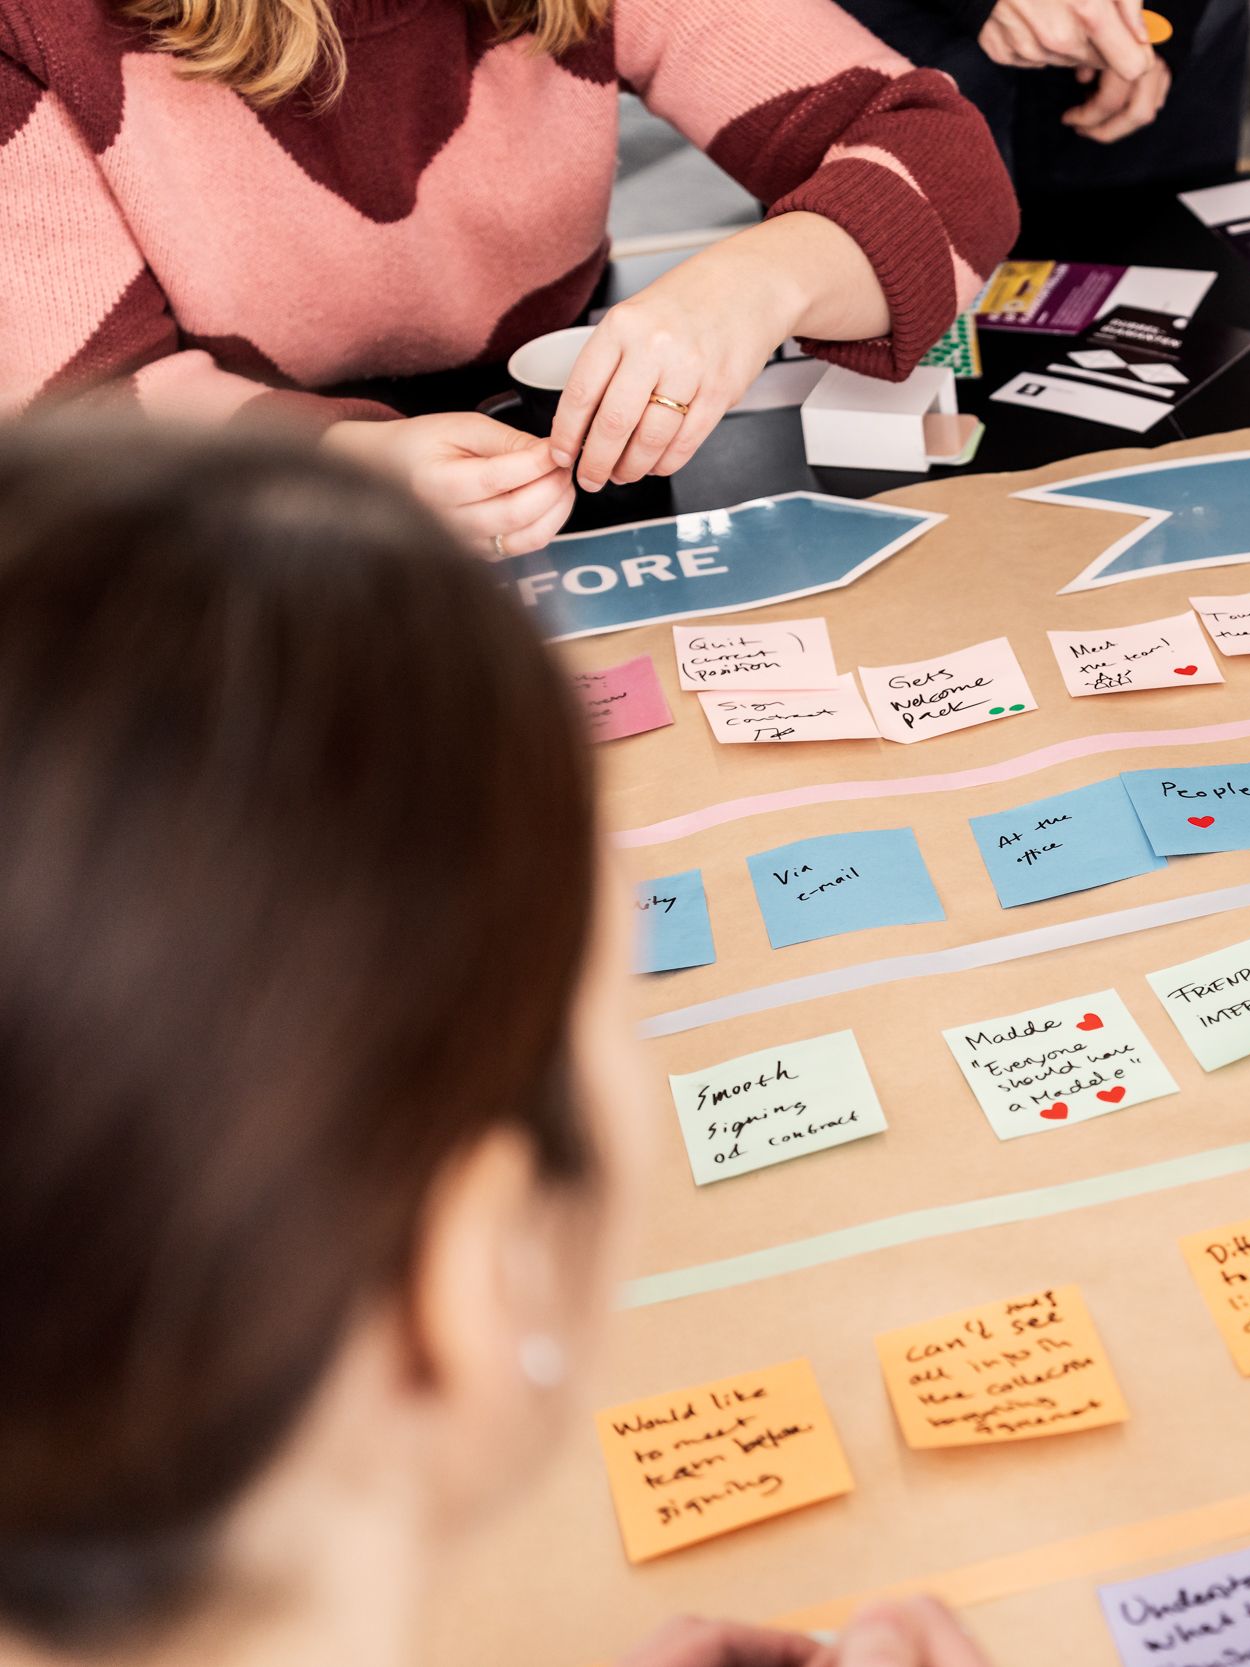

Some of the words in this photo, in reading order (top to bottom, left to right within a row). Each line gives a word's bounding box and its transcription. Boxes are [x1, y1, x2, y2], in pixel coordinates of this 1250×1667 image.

[512, 545, 729, 607] FORE
[688, 637, 762, 651] Quit
[1069, 640, 1119, 659] Meet
[888, 668, 954, 690] Gets
[1080, 662, 1118, 674] the
[717, 701, 785, 712] Sign
[998, 832, 1023, 849] At
[1034, 814, 1073, 831] the
[1016, 842, 1064, 866] office
[772, 864, 814, 886] Via
[796, 866, 861, 902] e-mail
[965, 1019, 1063, 1051] Madde
[997, 1060, 1081, 1093] should
[1087, 1044, 1136, 1063] have
[697, 1060, 800, 1111] Smooth
[1008, 1102, 1026, 1113] a
[768, 1110, 859, 1146] contract
[1011, 1312, 1063, 1336] see
[612, 1402, 696, 1436] Would
[710, 1388, 768, 1411] like
[634, 1449, 664, 1464] to
[673, 1415, 757, 1450] meet
[644, 1454, 726, 1489] team
[732, 1423, 814, 1453] before
[1143, 1612, 1235, 1652] what
